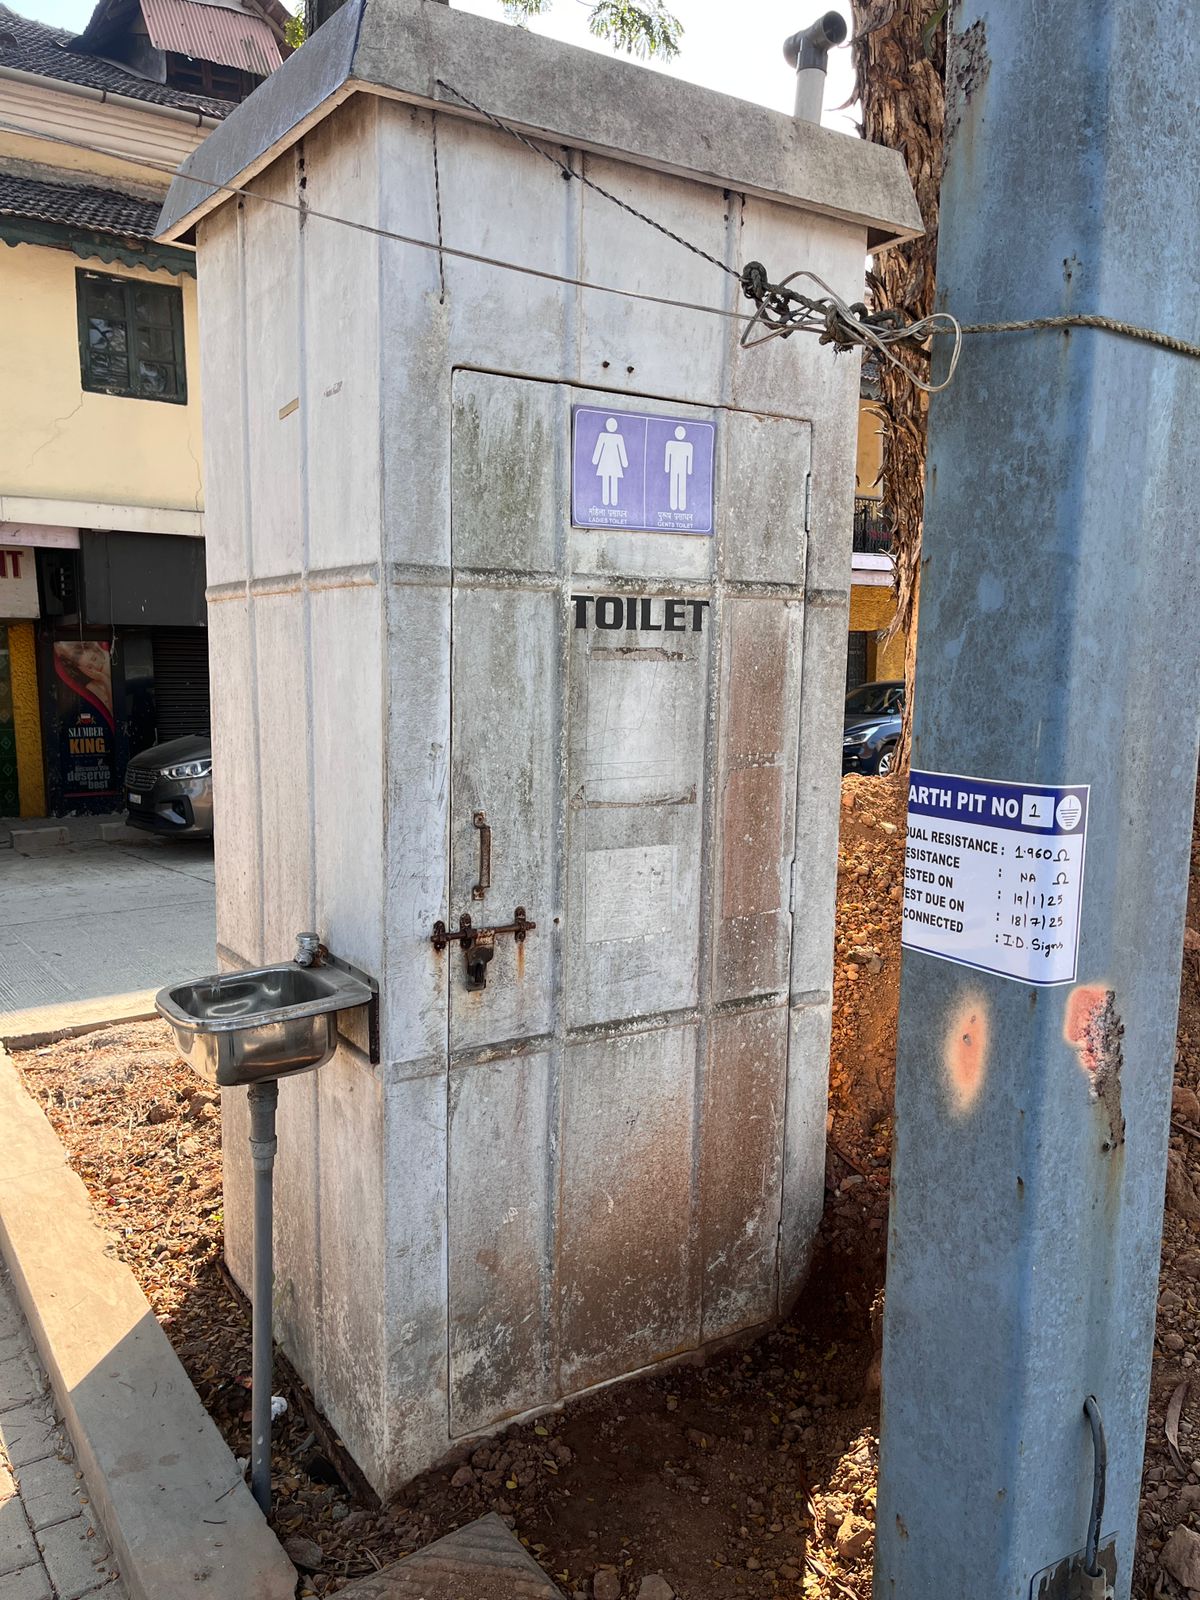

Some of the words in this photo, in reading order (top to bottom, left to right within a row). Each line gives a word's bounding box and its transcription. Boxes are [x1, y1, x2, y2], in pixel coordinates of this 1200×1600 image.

[571, 595, 710, 631] TOILET
[68, 727, 104, 737] SLUMBER
[69, 737, 105, 754] KING
[67, 770, 110, 781] deserve
[88, 780, 108, 789] best
[908, 784, 951, 808] ARTH
[956, 791, 987, 813] PIT
[991, 796, 1019, 818] NO
[1029, 803, 1041, 818] 1
[931, 831, 998, 855] RESISTANCE
[905, 847, 960, 869] ESISTANCE
[1020, 872, 1036, 883] NA
[905, 867, 934, 885] ESTED
[938, 874, 953, 889] ON
[904, 887, 923, 901] EST
[925, 892, 946, 908] DUE
[949, 898, 964, 913] ON
[903, 907, 964, 933] CONNECTED
